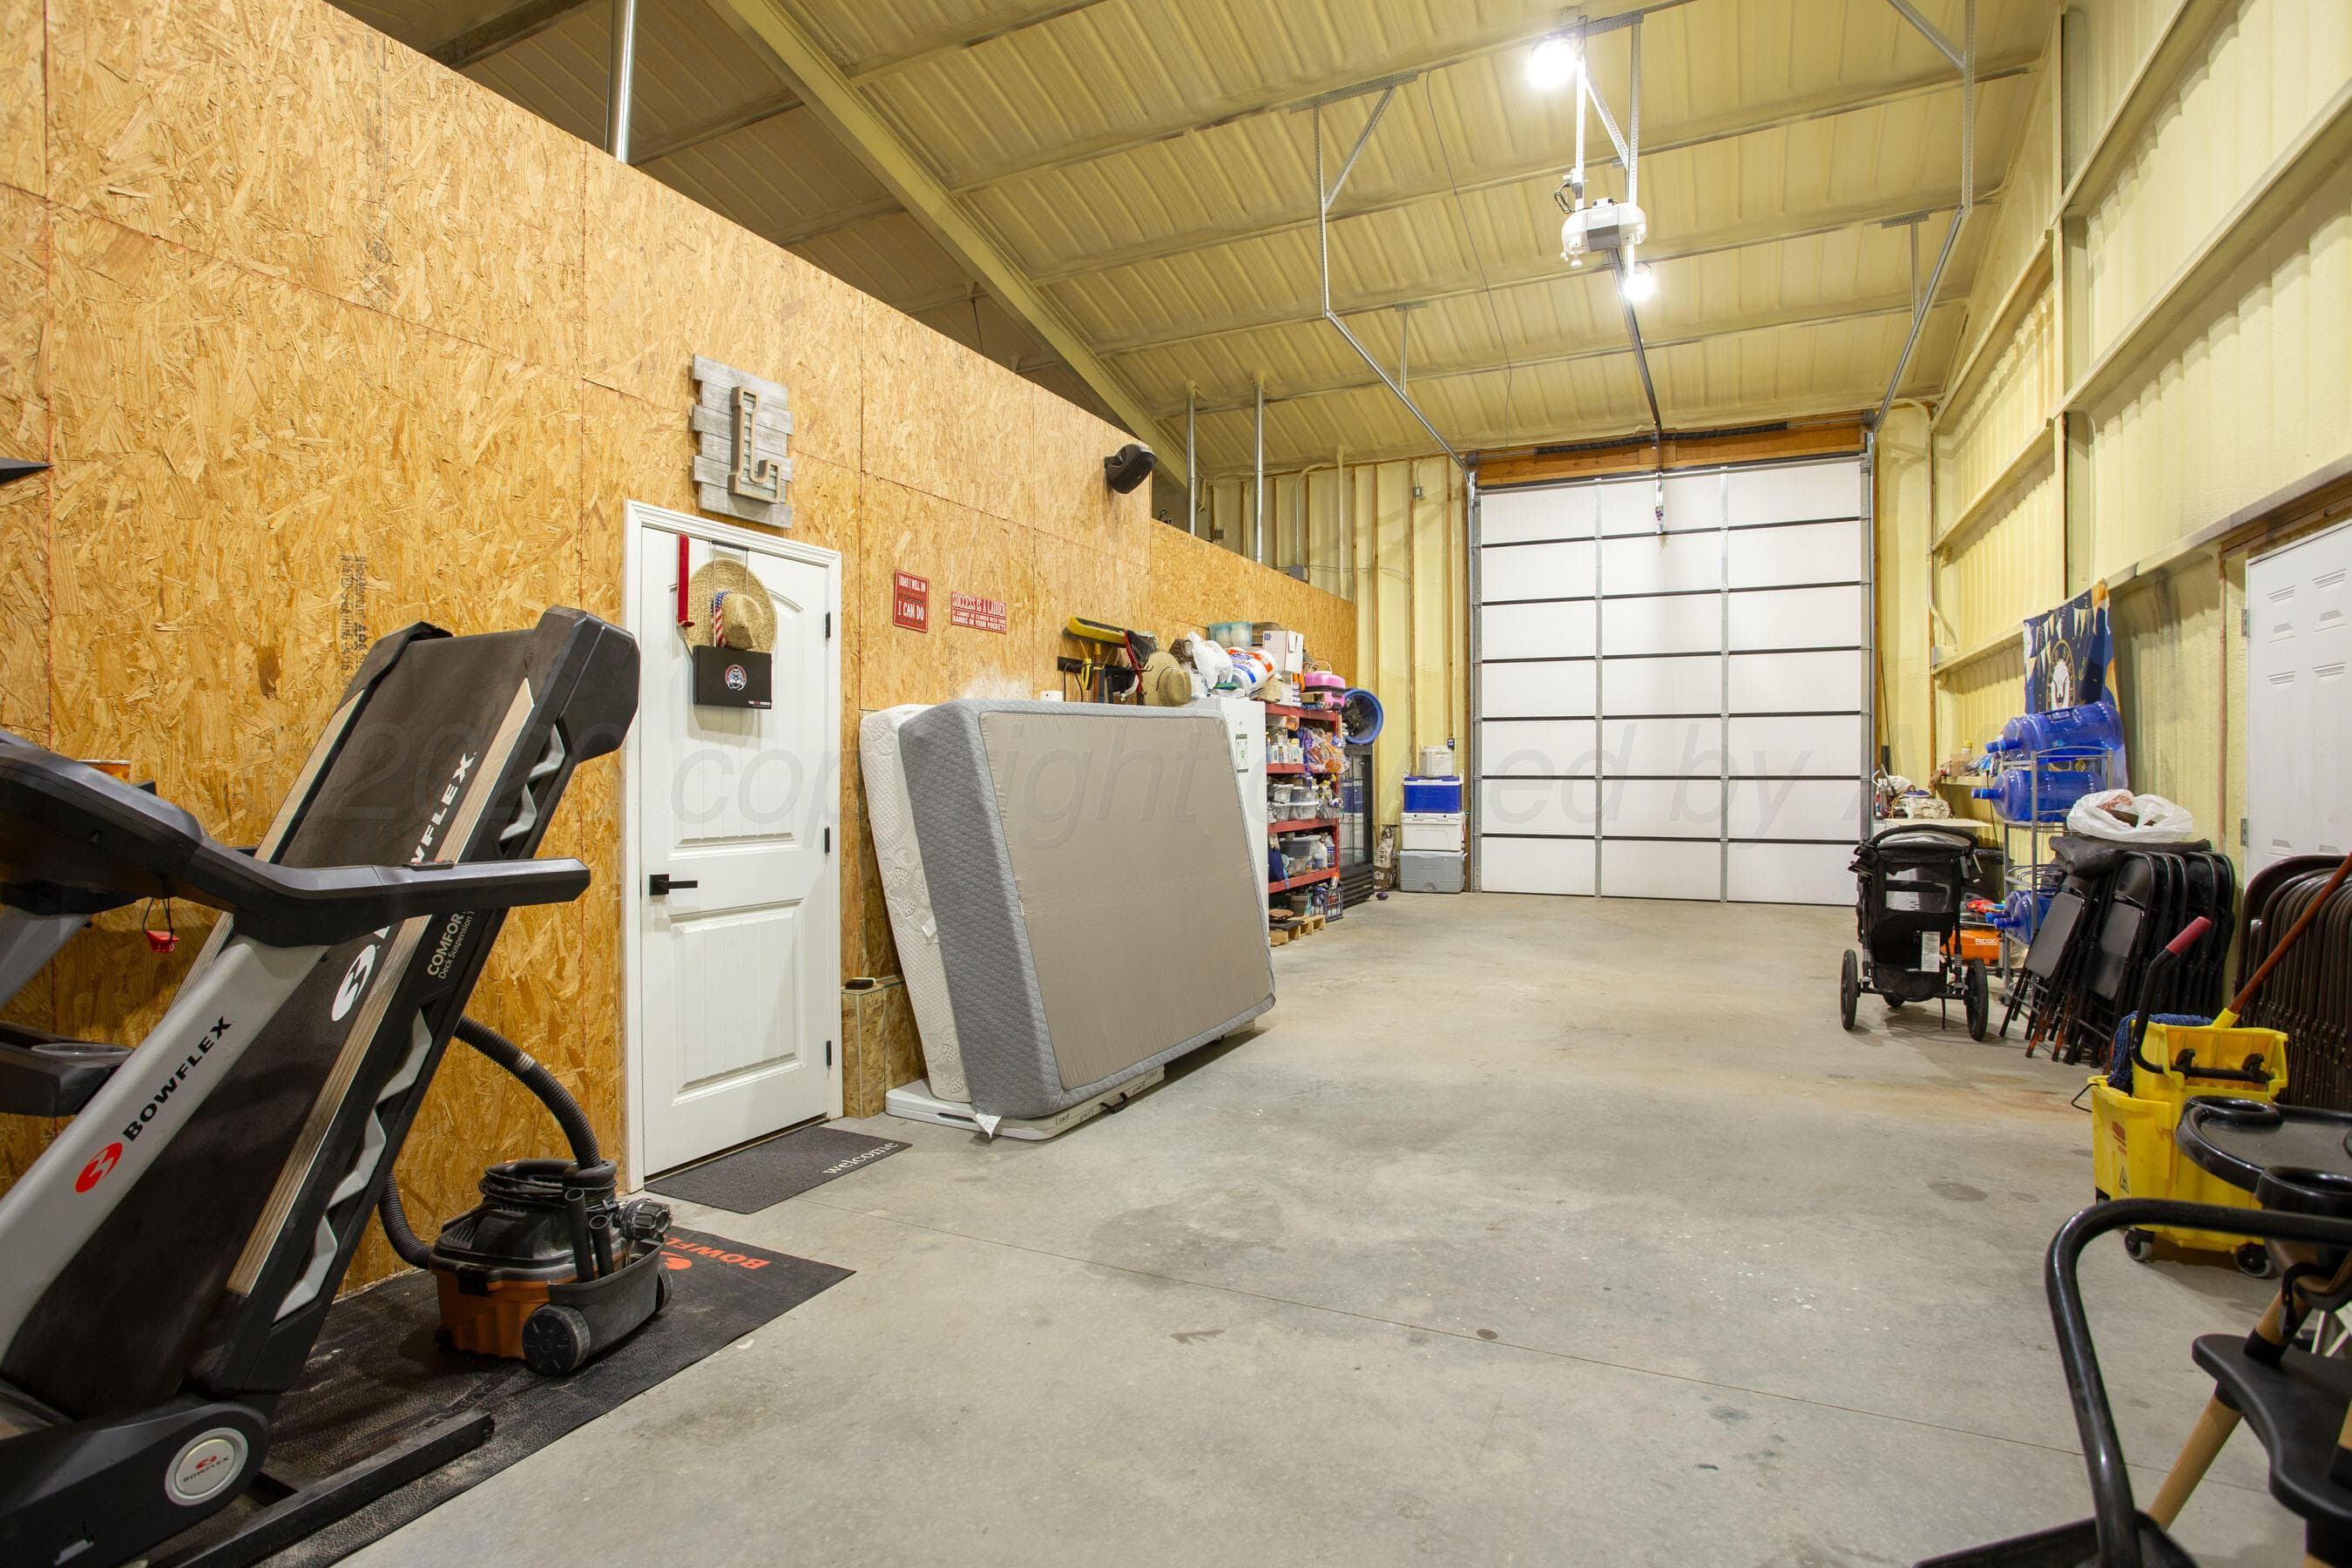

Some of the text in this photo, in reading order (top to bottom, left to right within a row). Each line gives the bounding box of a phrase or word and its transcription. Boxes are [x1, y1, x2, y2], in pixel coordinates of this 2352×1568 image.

[727, 385, 781, 505] L
[897, 600, 902, 616] I
[903, 602, 915, 618] CAN
[916, 605, 924, 621] DO
[952, 592, 976, 612] SUCCESS
[977, 598, 982, 612] IS
[987, 599, 1006, 617] LADDER
[952, 615, 969, 625] HANDS
[976, 619, 987, 628] YOUR
[987, 621, 1006, 631] POCKETS
[427, 912, 464, 976] COMFOR
[438, 916, 472, 979] Deck Suspension
[122, 1016, 232, 1142] BOWFLEX
[821, 1140, 899, 1175] welcome
[665, 1237, 771, 1270] BOWFL
[183, 1456, 229, 1483] BOWFLEX
